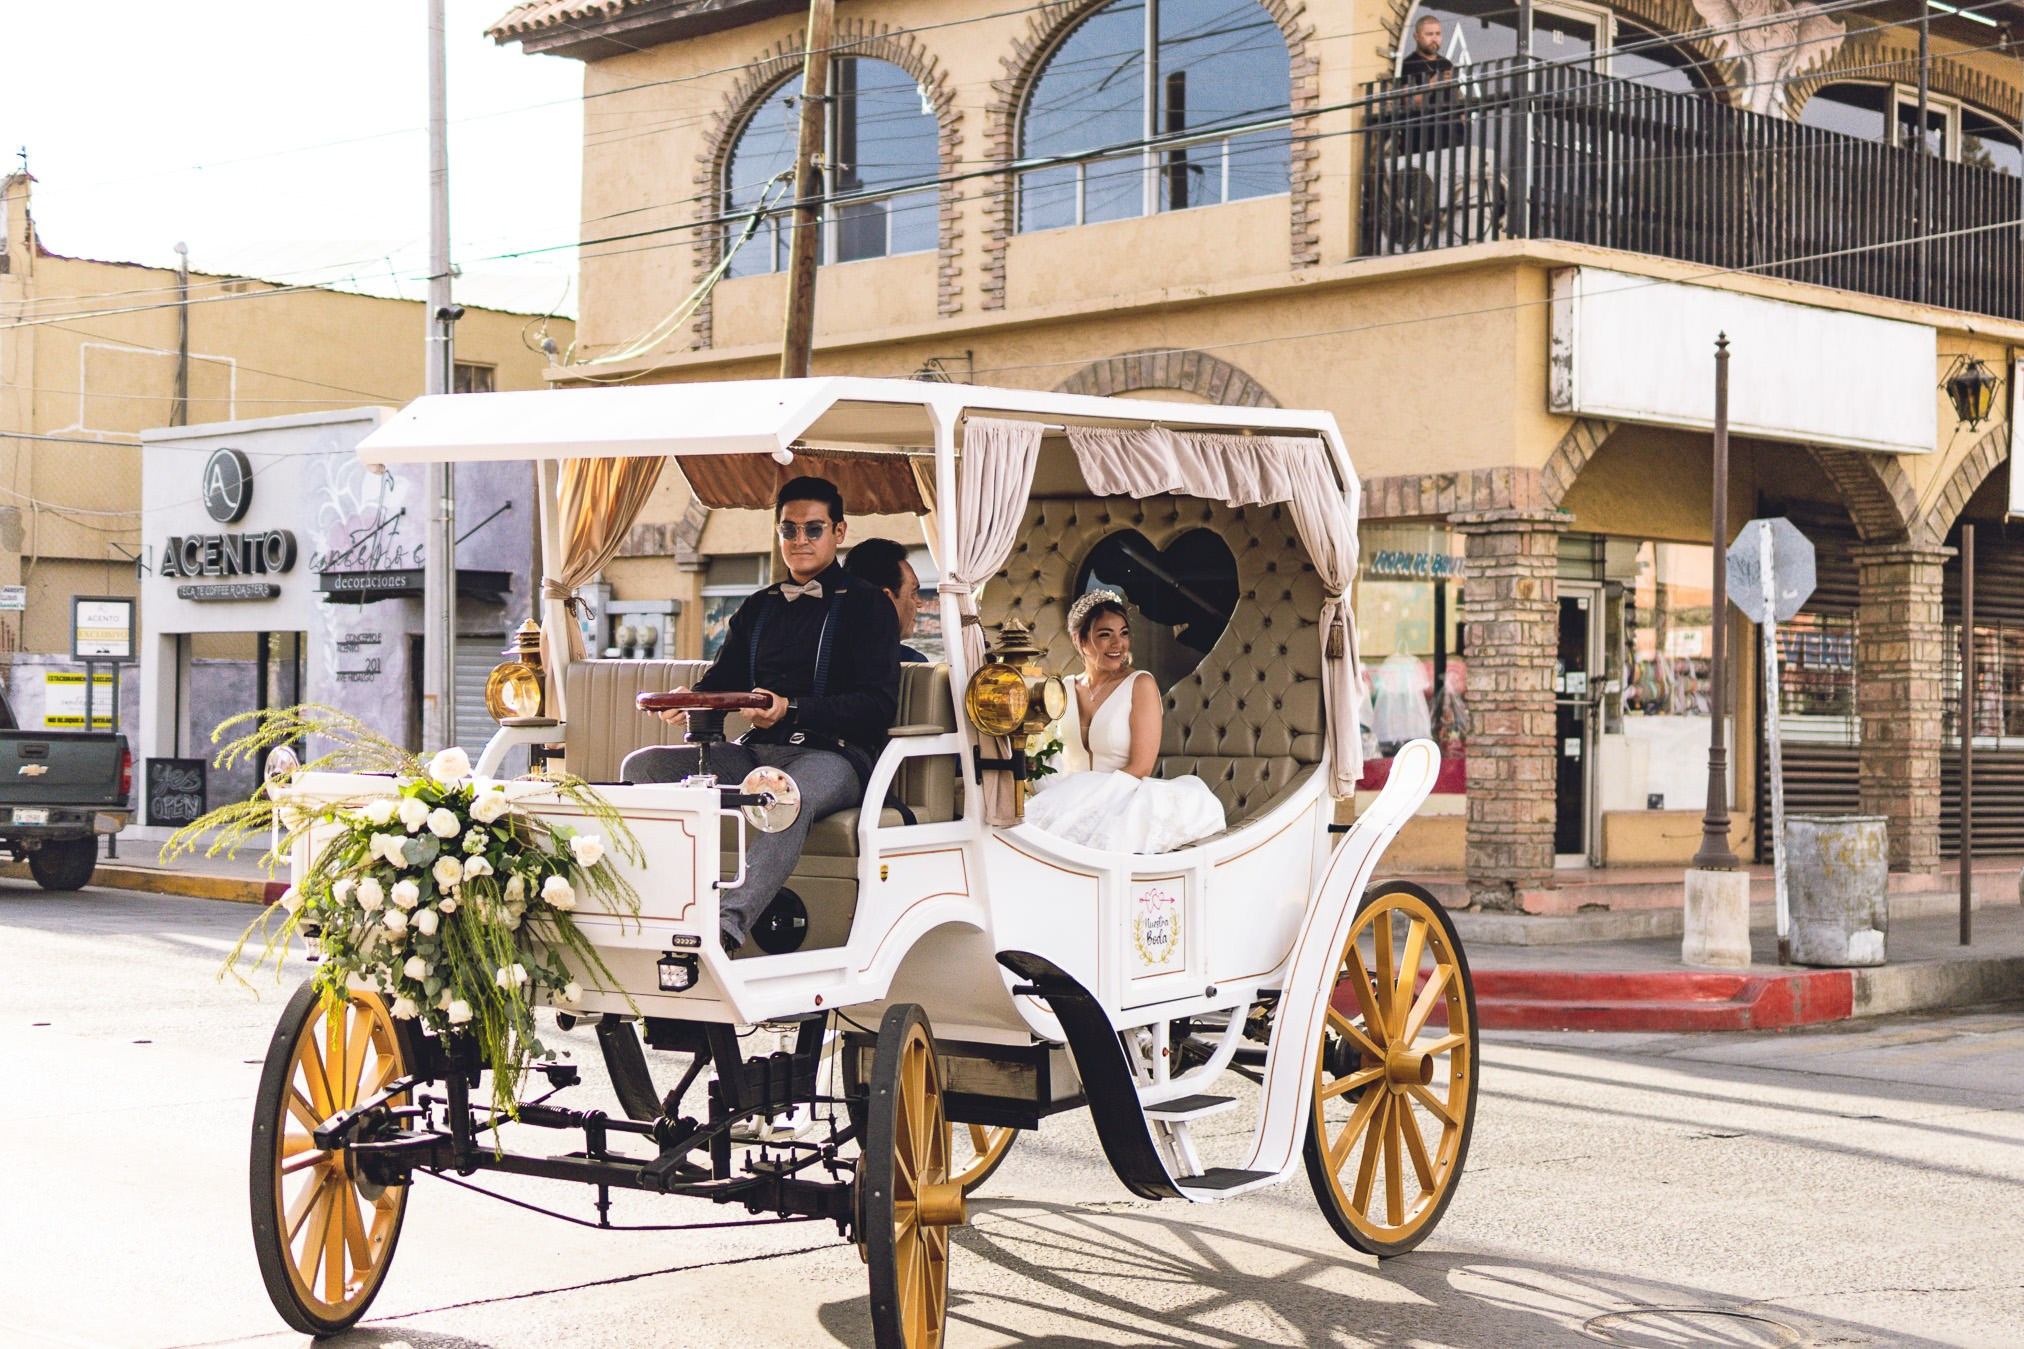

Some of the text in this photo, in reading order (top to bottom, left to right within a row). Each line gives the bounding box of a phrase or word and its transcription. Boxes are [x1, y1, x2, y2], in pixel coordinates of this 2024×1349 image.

[160, 528, 297, 577] ACENTO
[1371, 549, 1411, 575] ROPA
[1411, 551, 1429, 577] DE
[335, 574, 407, 590] decoraciones
[230, 583, 270, 598] ROASTERS
[87, 615, 120, 623] ACENTO
[365, 657, 381, 672] 201
[151, 794, 202, 820] OPEN
[1145, 915, 1169, 929] Nuestra
[1146, 928, 1168, 946] Boda
